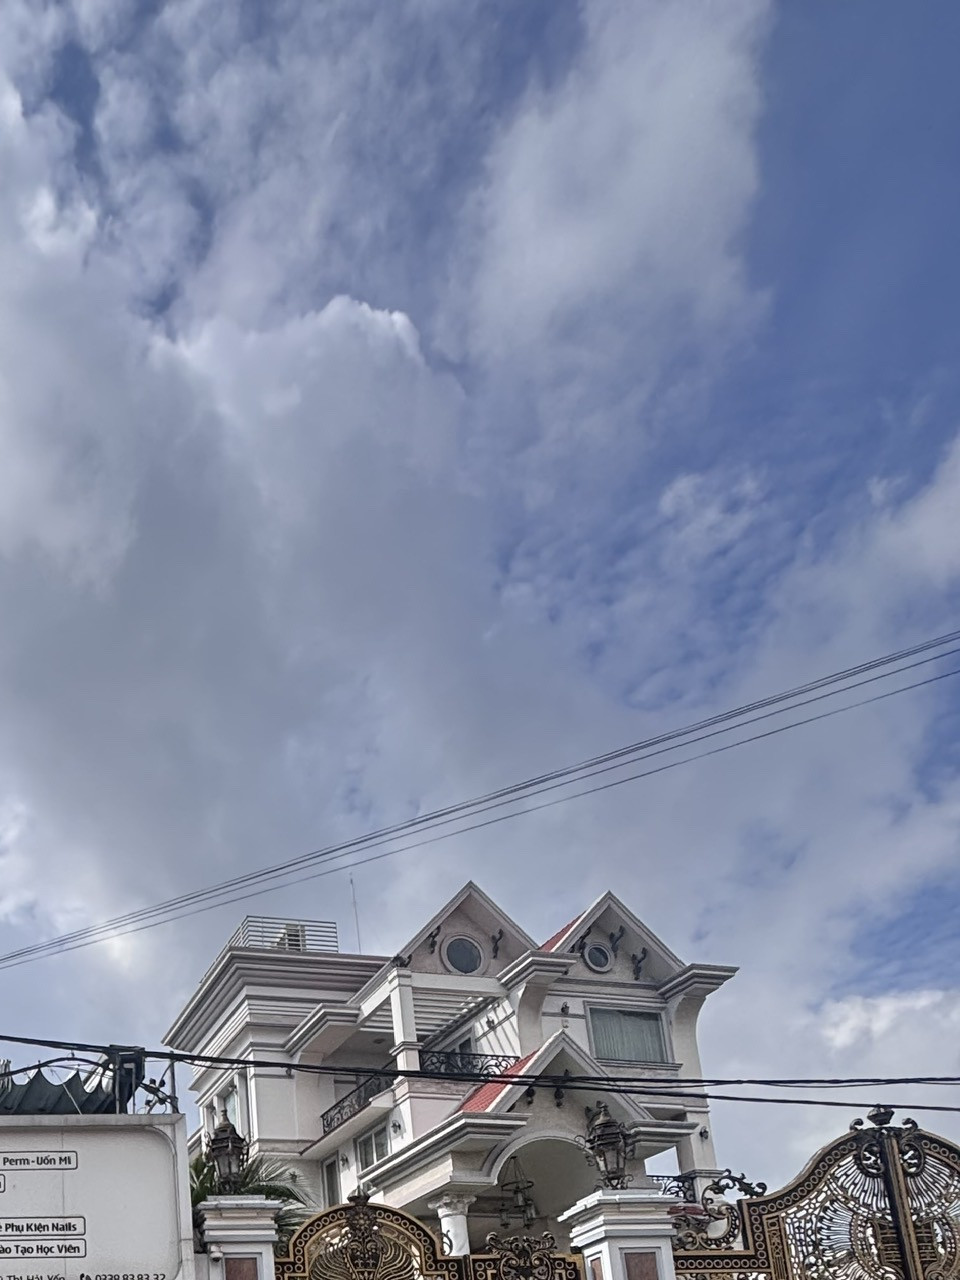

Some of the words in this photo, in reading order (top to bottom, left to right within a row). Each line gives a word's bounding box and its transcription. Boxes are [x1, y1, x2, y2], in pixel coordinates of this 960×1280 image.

[5, 1222, 25, 1234] Phụ
[26, 1222, 49, 1233] Kiện
[51, 1222, 77, 1232] Nails
[14, 1244, 34, 1255] Tạo
[36, 1244, 54, 1255] Học
[57, 1244, 80, 1254] Viên
